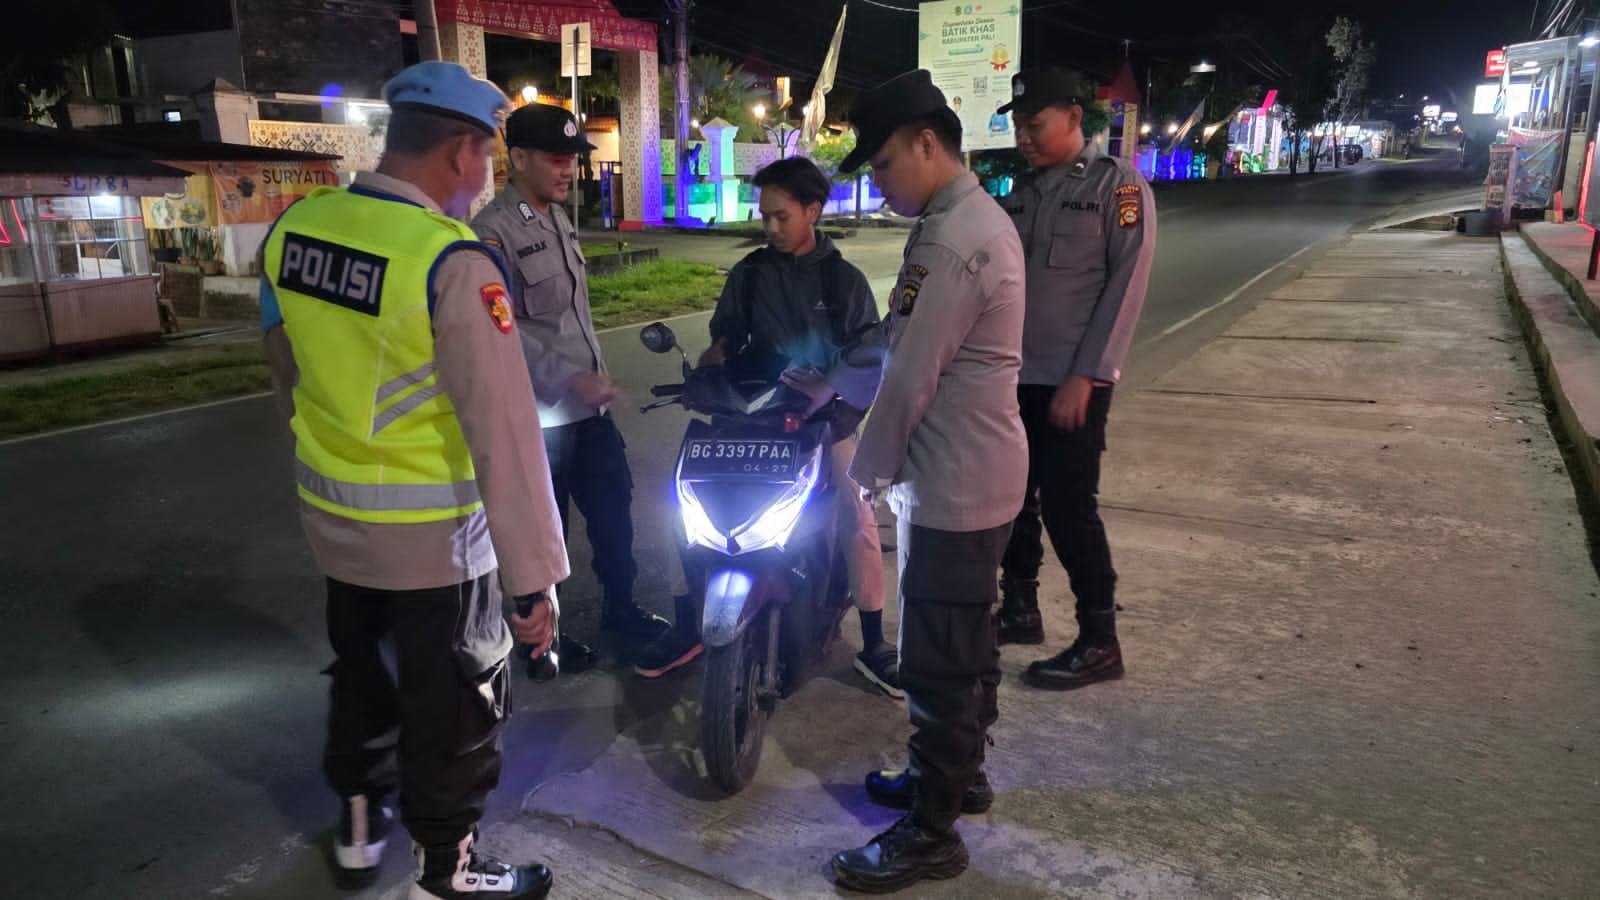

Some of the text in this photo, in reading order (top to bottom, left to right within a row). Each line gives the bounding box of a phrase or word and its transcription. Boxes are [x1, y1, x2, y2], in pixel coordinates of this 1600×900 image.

[942, 24, 995, 37] BATIK KHAS
[262, 169, 326, 185] SURYATI
[1062, 201, 1100, 213] POLRI
[283, 242, 380, 304] POLISI
[690, 444, 791, 459] BG 3397 PAA
